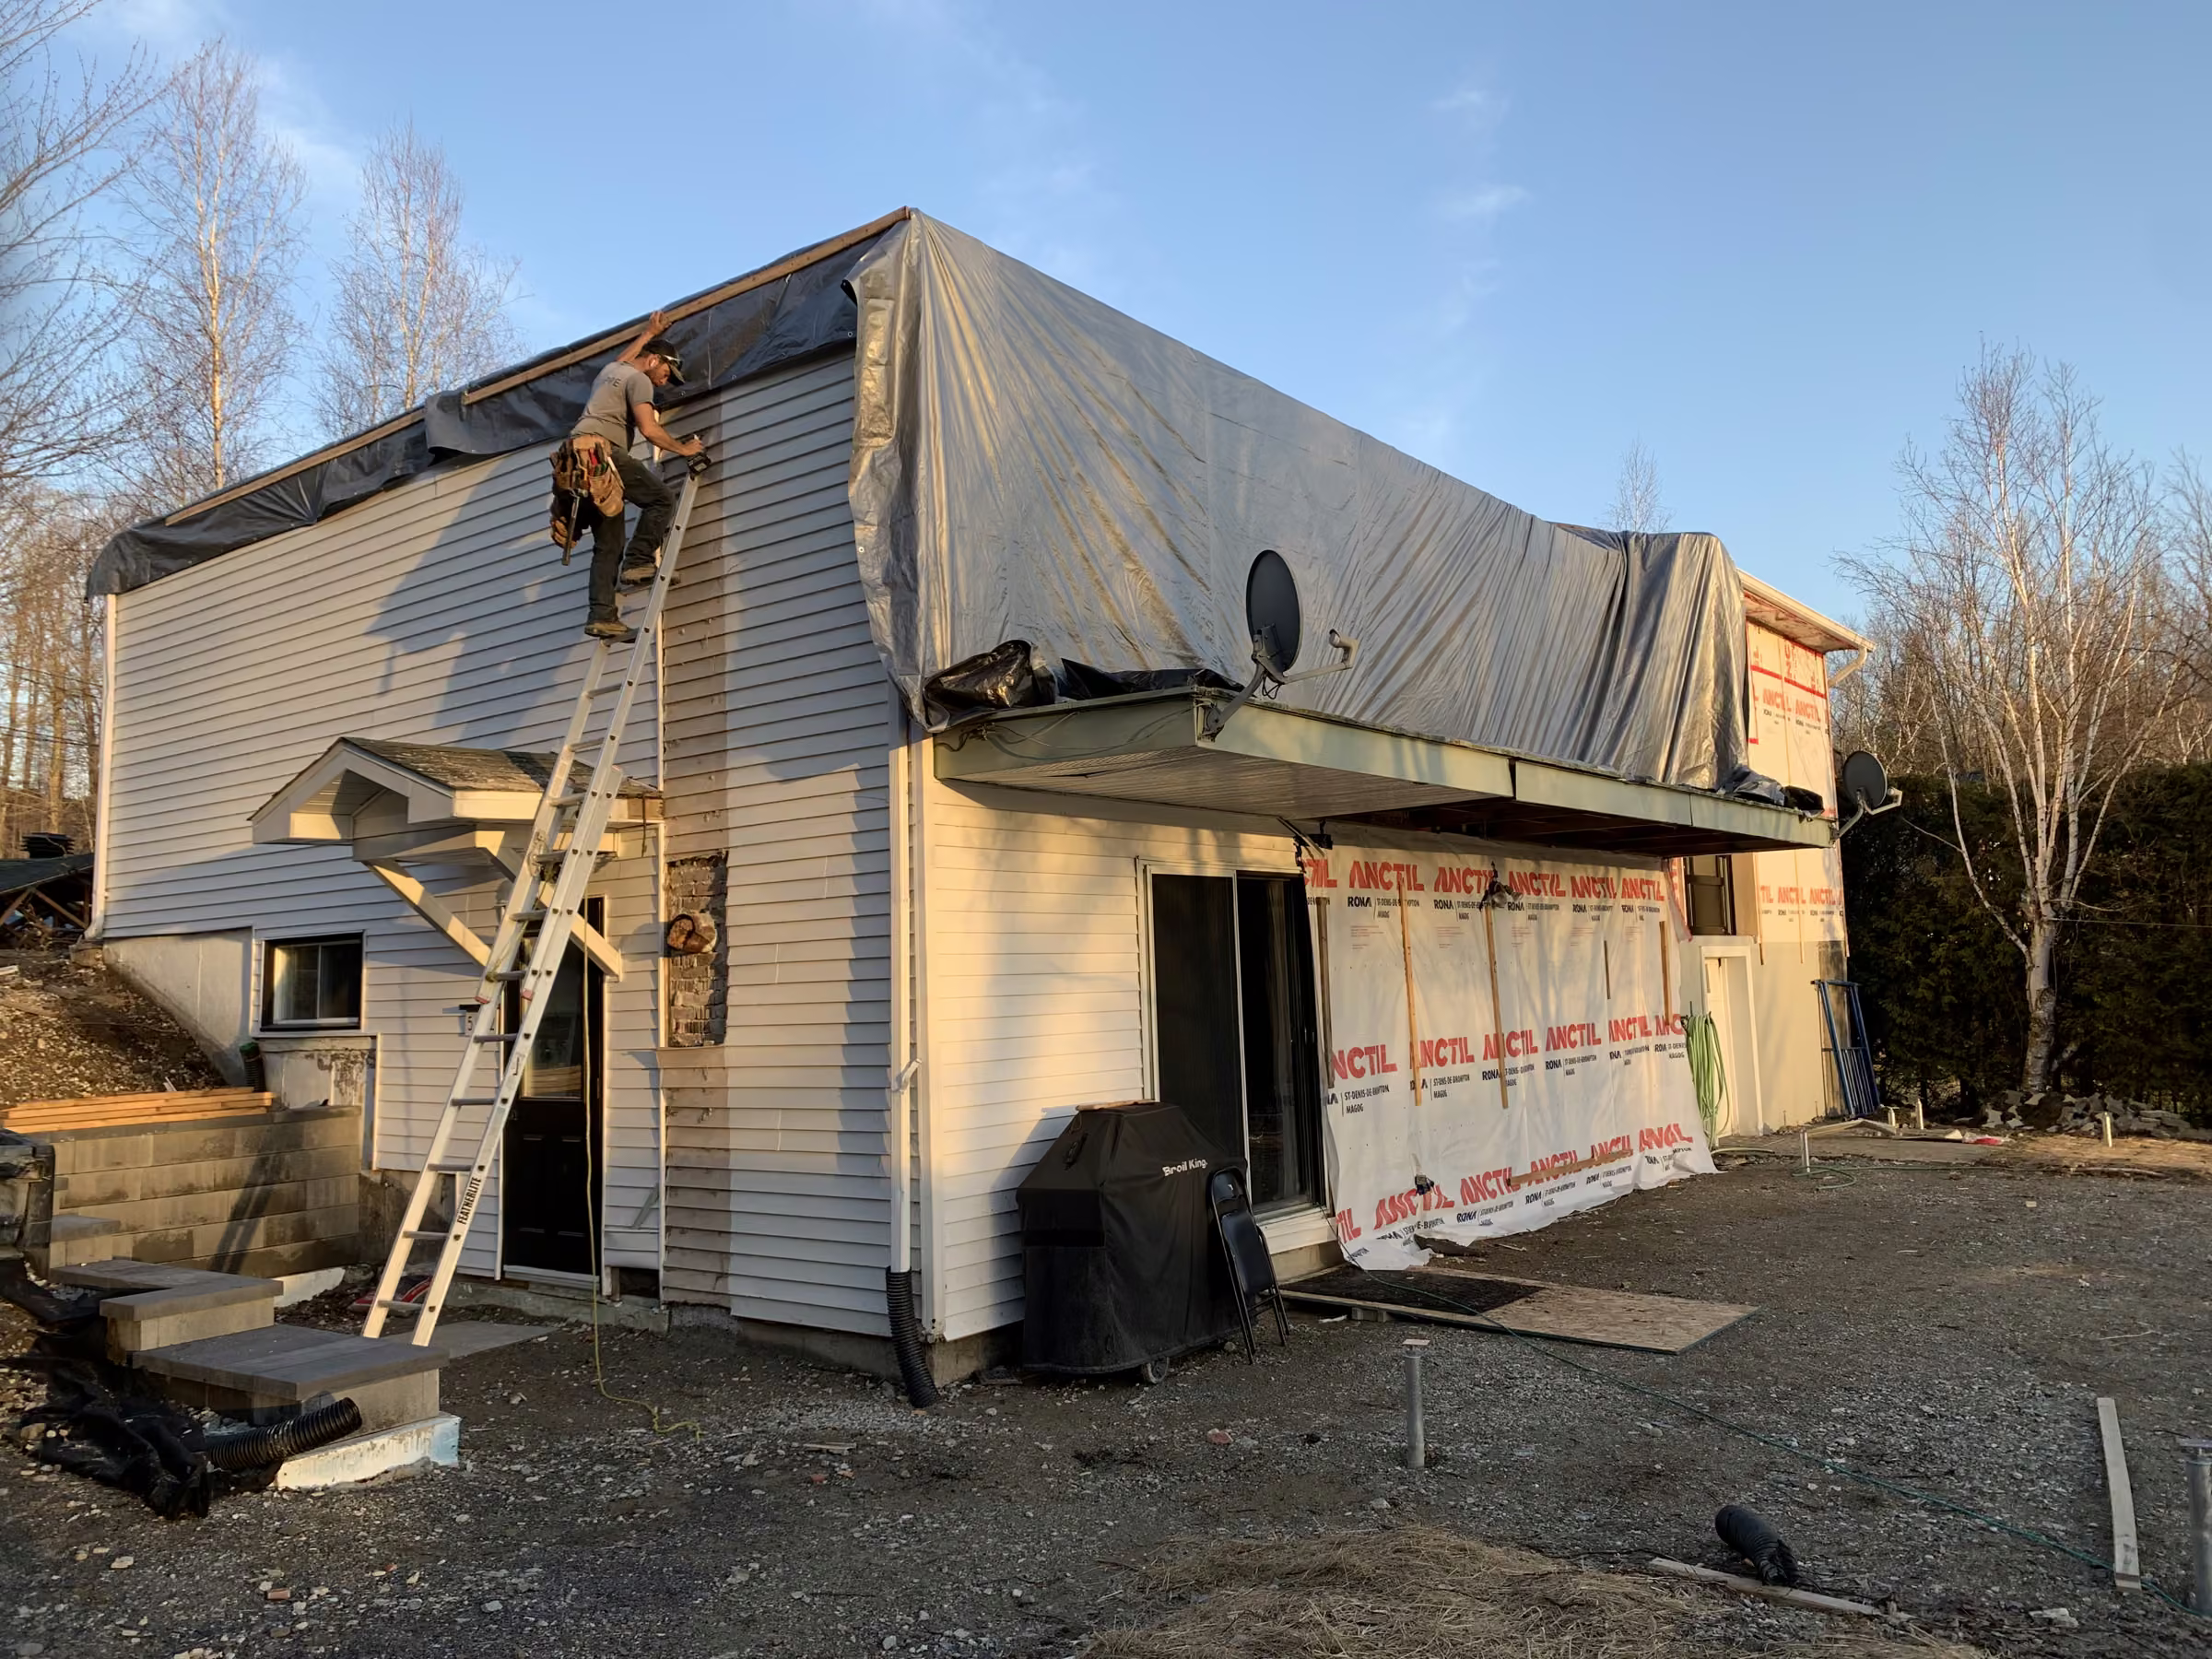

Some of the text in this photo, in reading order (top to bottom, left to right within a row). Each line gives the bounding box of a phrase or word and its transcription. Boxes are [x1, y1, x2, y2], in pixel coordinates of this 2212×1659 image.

[1349, 861, 1424, 891] ANCTIL
[1347, 896, 1371, 907] RONA
[1434, 900, 1454, 910] RONA
[1546, 1023, 1601, 1052] ANCTIL
[1332, 1044, 1397, 1079] NCTIL
[1546, 1059, 1561, 1069] RONA
[1347, 1104, 1363, 1113] MAGOG
[1162, 1159, 1206, 1176] Broil King
[457, 1177, 481, 1224] FEATHERLITE
[1525, 1192, 1541, 1205] RONA
[1457, 1211, 1477, 1223] RONA
